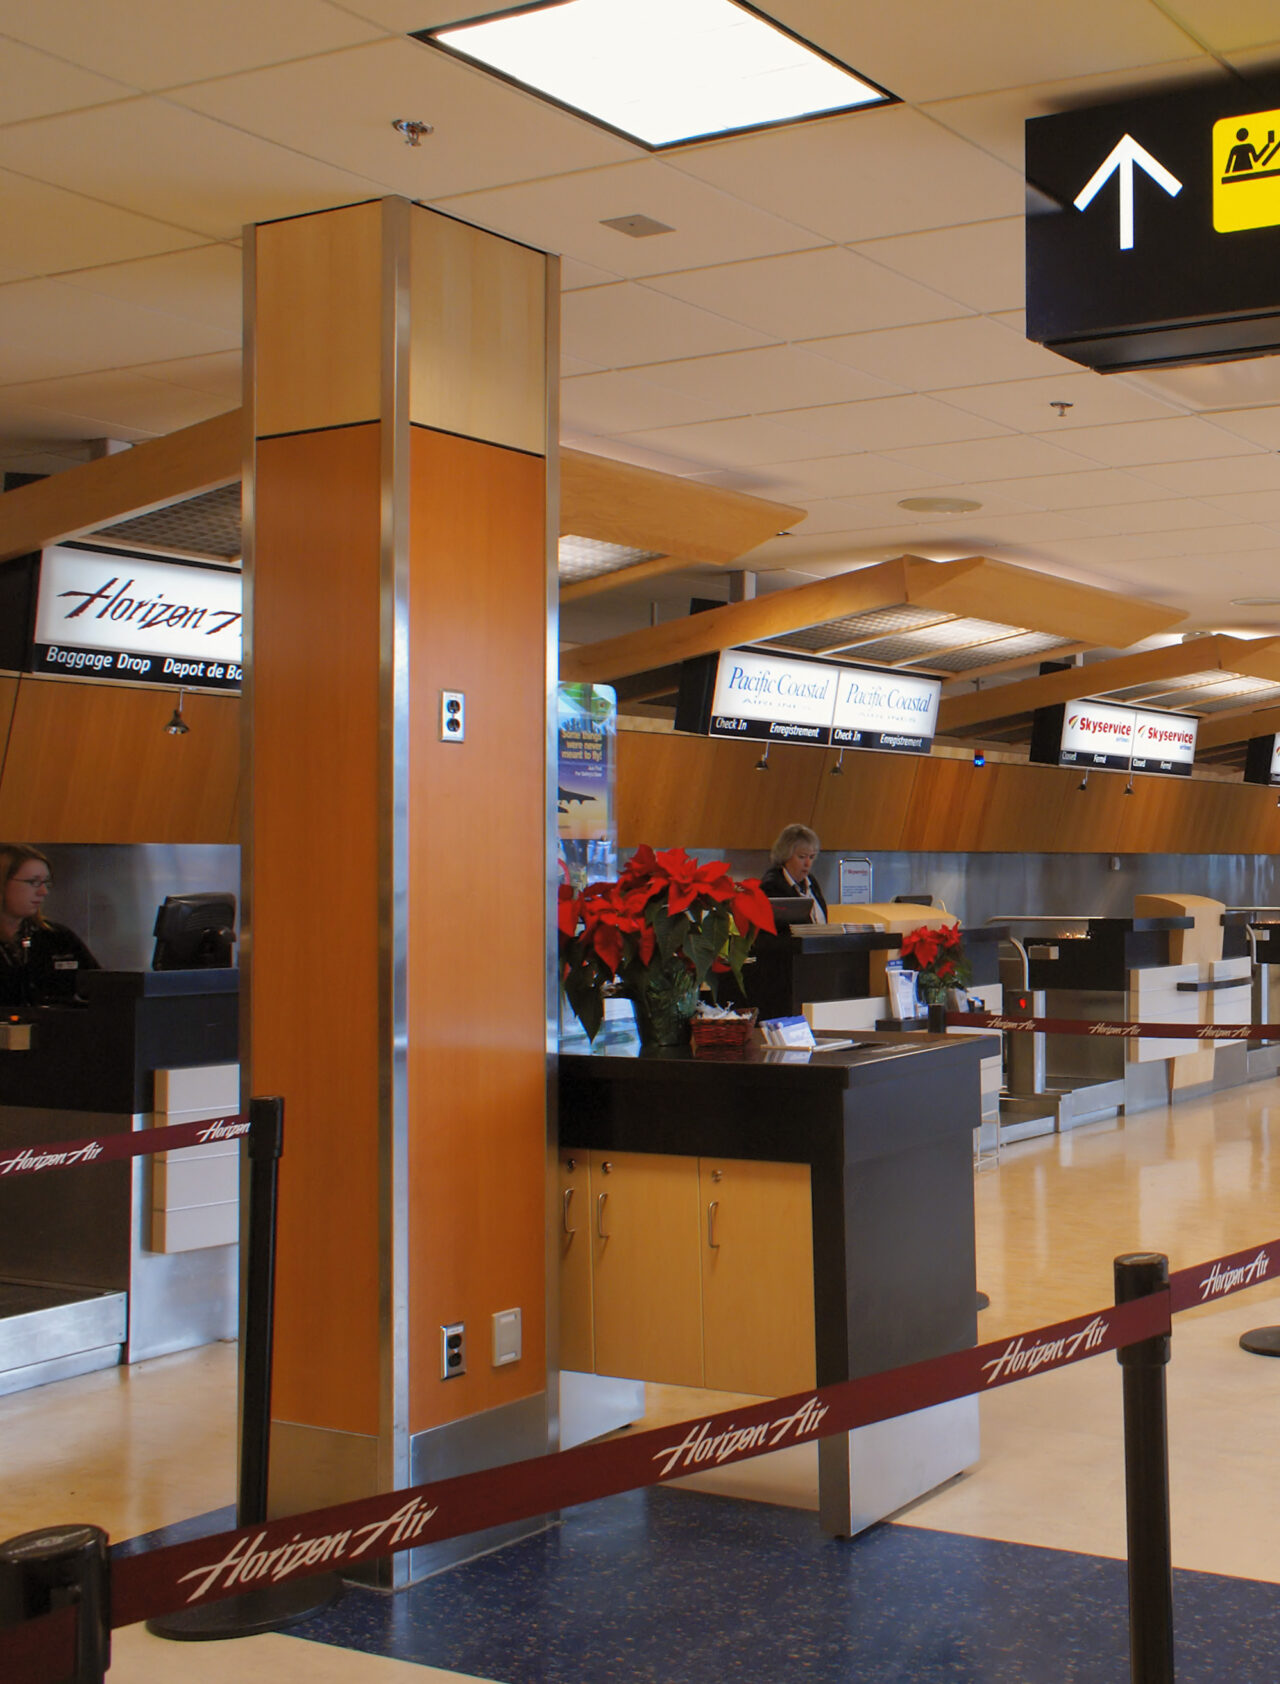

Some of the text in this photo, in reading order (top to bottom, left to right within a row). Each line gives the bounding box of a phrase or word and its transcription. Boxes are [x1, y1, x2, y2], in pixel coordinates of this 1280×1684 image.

[57, 577, 208, 631] Horizon
[46, 645, 113, 671] Baggage
[116, 652, 151, 675] Drop
[163, 658, 205, 678] Depot
[206, 663, 225, 679] de
[728, 667, 829, 701] Pacific Coastal
[845, 683, 932, 714] Pacific Coastal
[716, 717, 819, 738] Check In Enregistrement
[834, 729, 922, 748] Check In Enregistrement
[1079, 717, 1132, 736] Skyservice
[1147, 727, 1193, 745] Skyservice
[195, 1119, 251, 1143] Horizon
[0, 1142, 103, 1174] Horizon Air
[1200, 1250, 1270, 1300] Horizon Air
[981, 1315, 1110, 1385] Horizon Air
[651, 1396, 830, 1477] Horizon Air
[177, 1495, 438, 1604] Horizon Air
